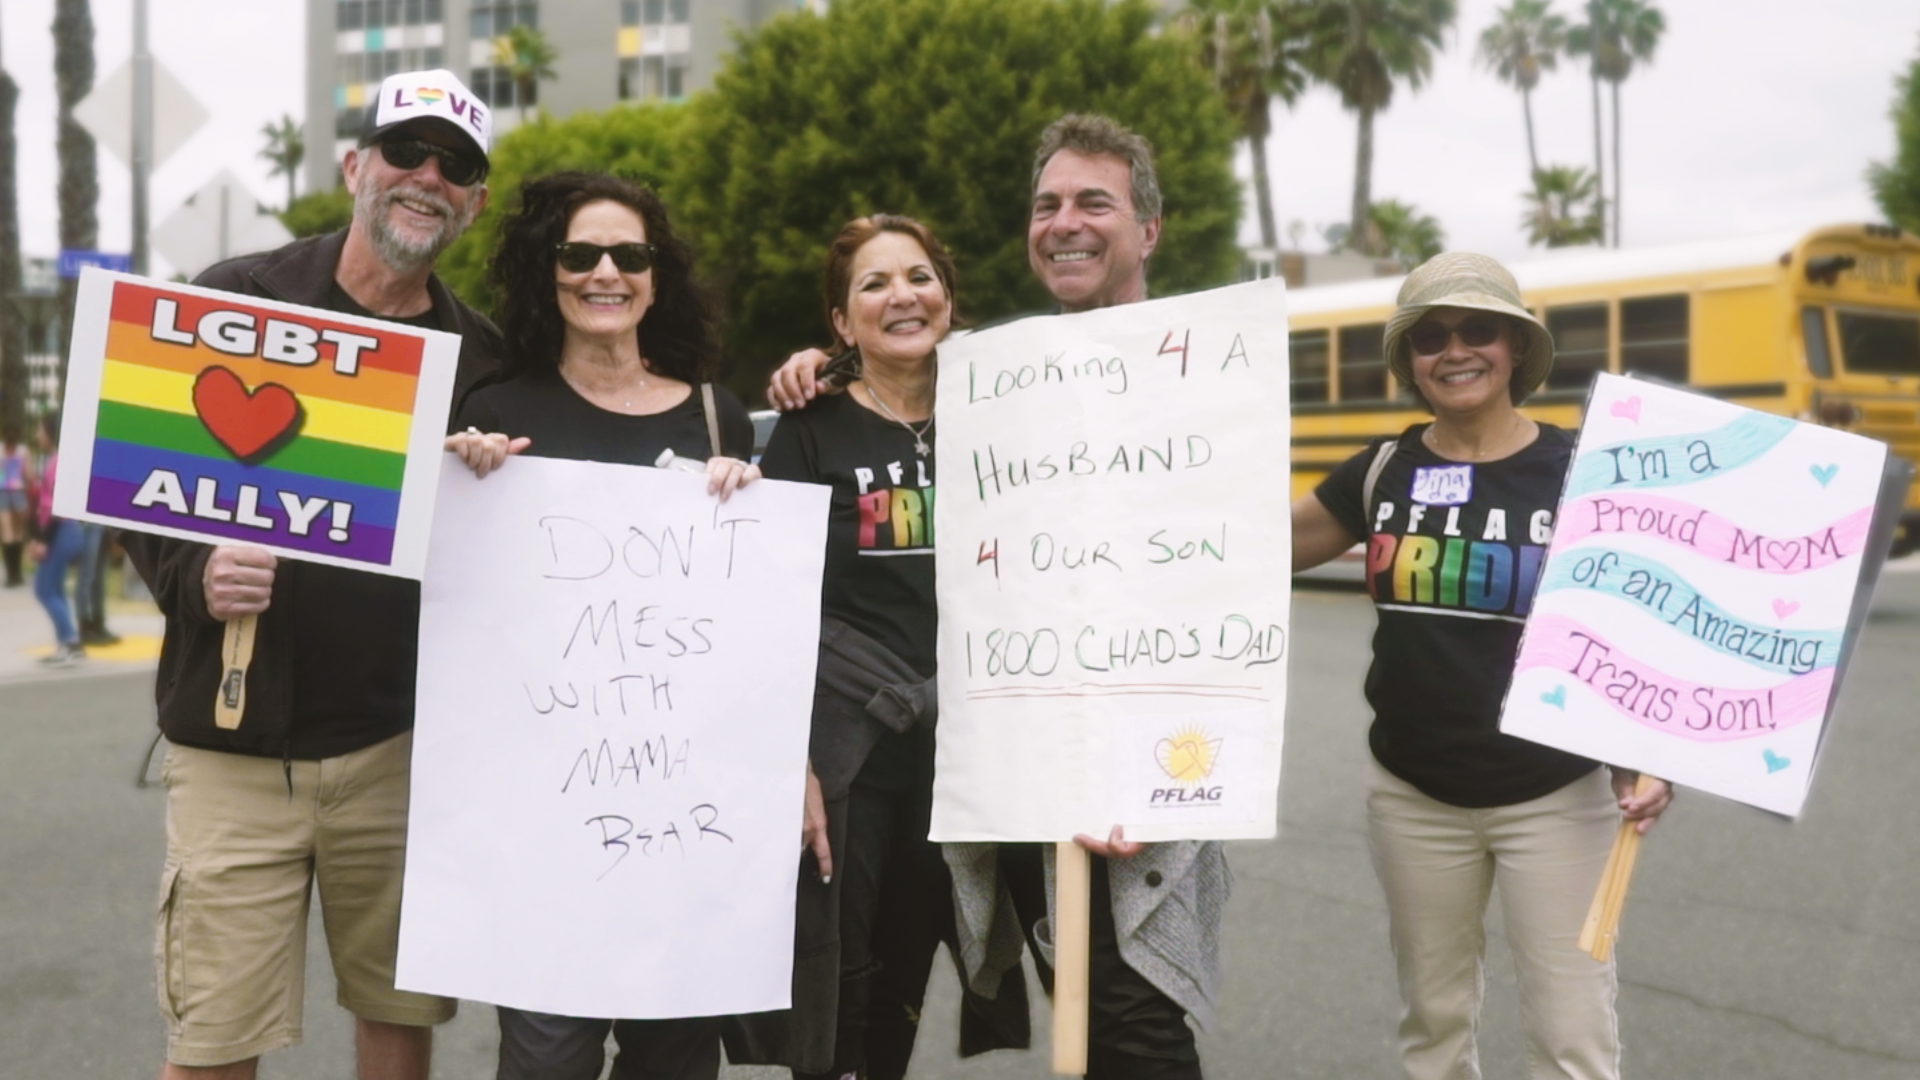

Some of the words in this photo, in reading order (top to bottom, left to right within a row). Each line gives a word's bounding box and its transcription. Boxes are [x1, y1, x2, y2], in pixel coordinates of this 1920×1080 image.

[151, 298, 379, 377] LGBT
[1157, 328, 1190, 378] 4
[1221, 333, 1250, 371] A
[854, 460, 932, 495] PFL
[972, 435, 1212, 502] HUSBAND
[1601, 445, 1670, 485] I'm
[1686, 440, 1721, 474] a
[131, 468, 353, 542] ALLY!
[856, 486, 935, 548] PRI
[1374, 501, 1553, 546] PFLAG
[1590, 498, 1709, 546] Proud
[539, 503, 761, 580] DON'T
[976, 537, 1000, 580] 4
[1031, 533, 1122, 572] OUR
[1148, 522, 1226, 563] SON
[562, 600, 714, 662] MESS
[1572, 552, 1619, 588] of
[1622, 569, 1673, 612] an
[1669, 594, 1824, 676] Amazing
[966, 627, 1060, 678] 1800
[1075, 623, 1201, 672] CHAD'S
[1210, 613, 1285, 669] DAD
[523, 673, 673, 716] WITH
[1568, 631, 1679, 723] Trans
[1685, 687, 1778, 731] Son!
[561, 734, 690, 793] MAMA
[1150, 786, 1223, 803] PFLAG
[584, 803, 734, 882] BEAR
